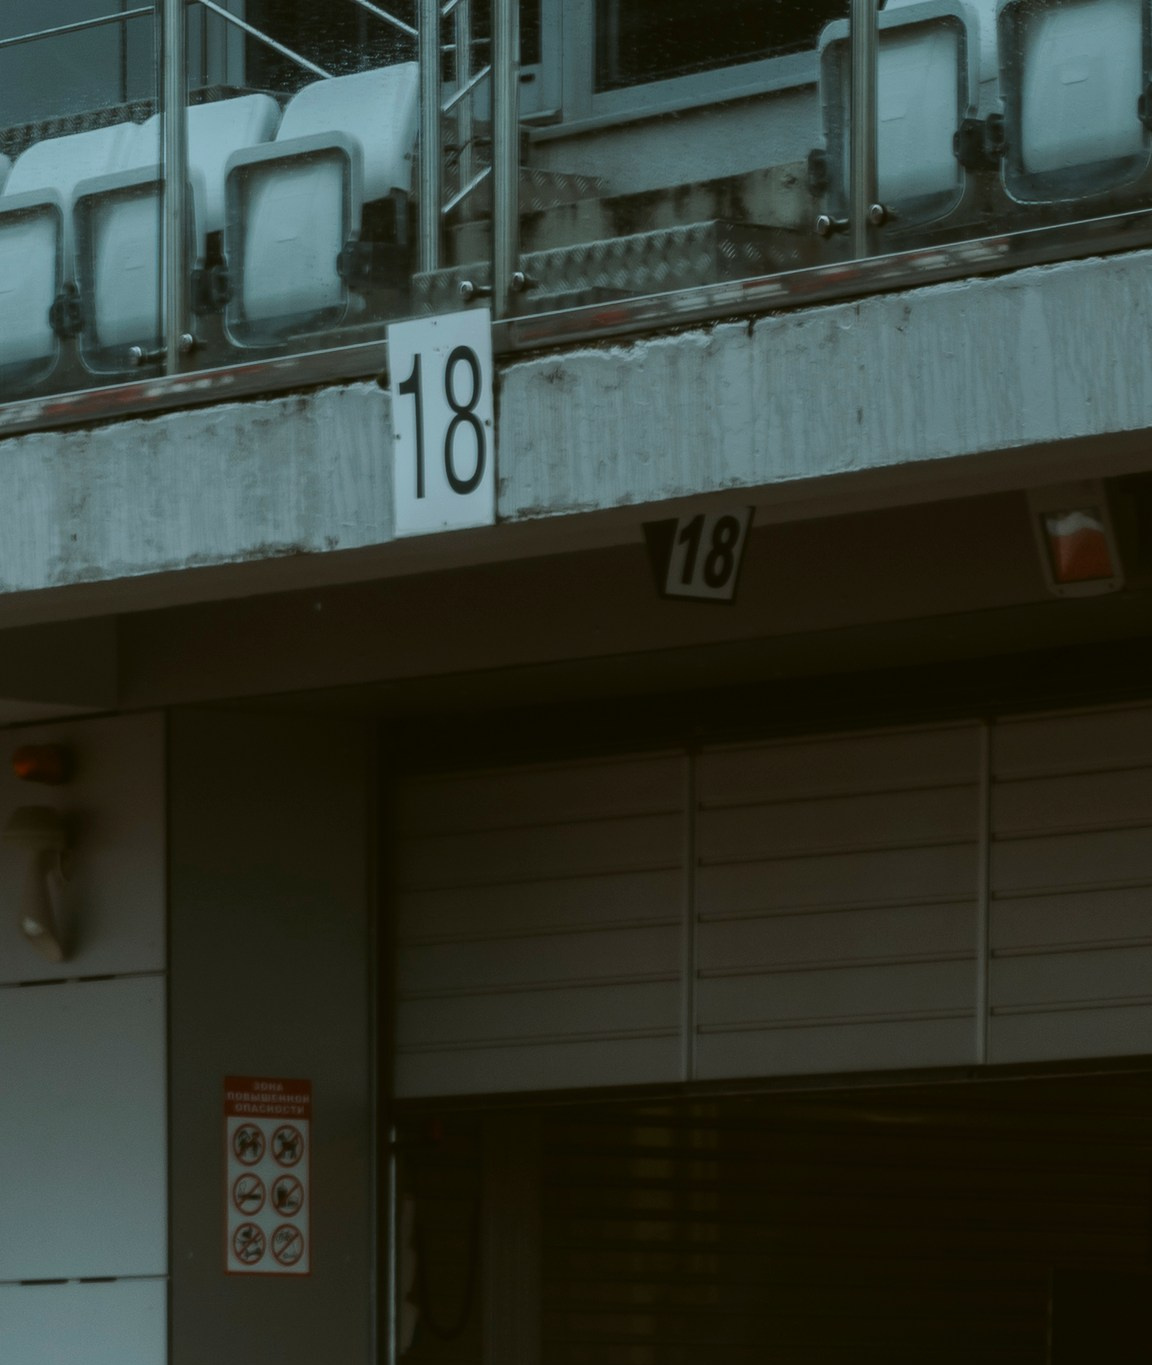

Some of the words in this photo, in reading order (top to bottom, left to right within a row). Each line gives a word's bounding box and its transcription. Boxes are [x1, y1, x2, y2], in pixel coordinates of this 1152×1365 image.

[397, 345, 487, 499] 18
[677, 514, 740, 590] 18
[253, 1081, 284, 1091] ЗОНА
[234, 1103, 304, 1114] ОПАСНОСТИ
